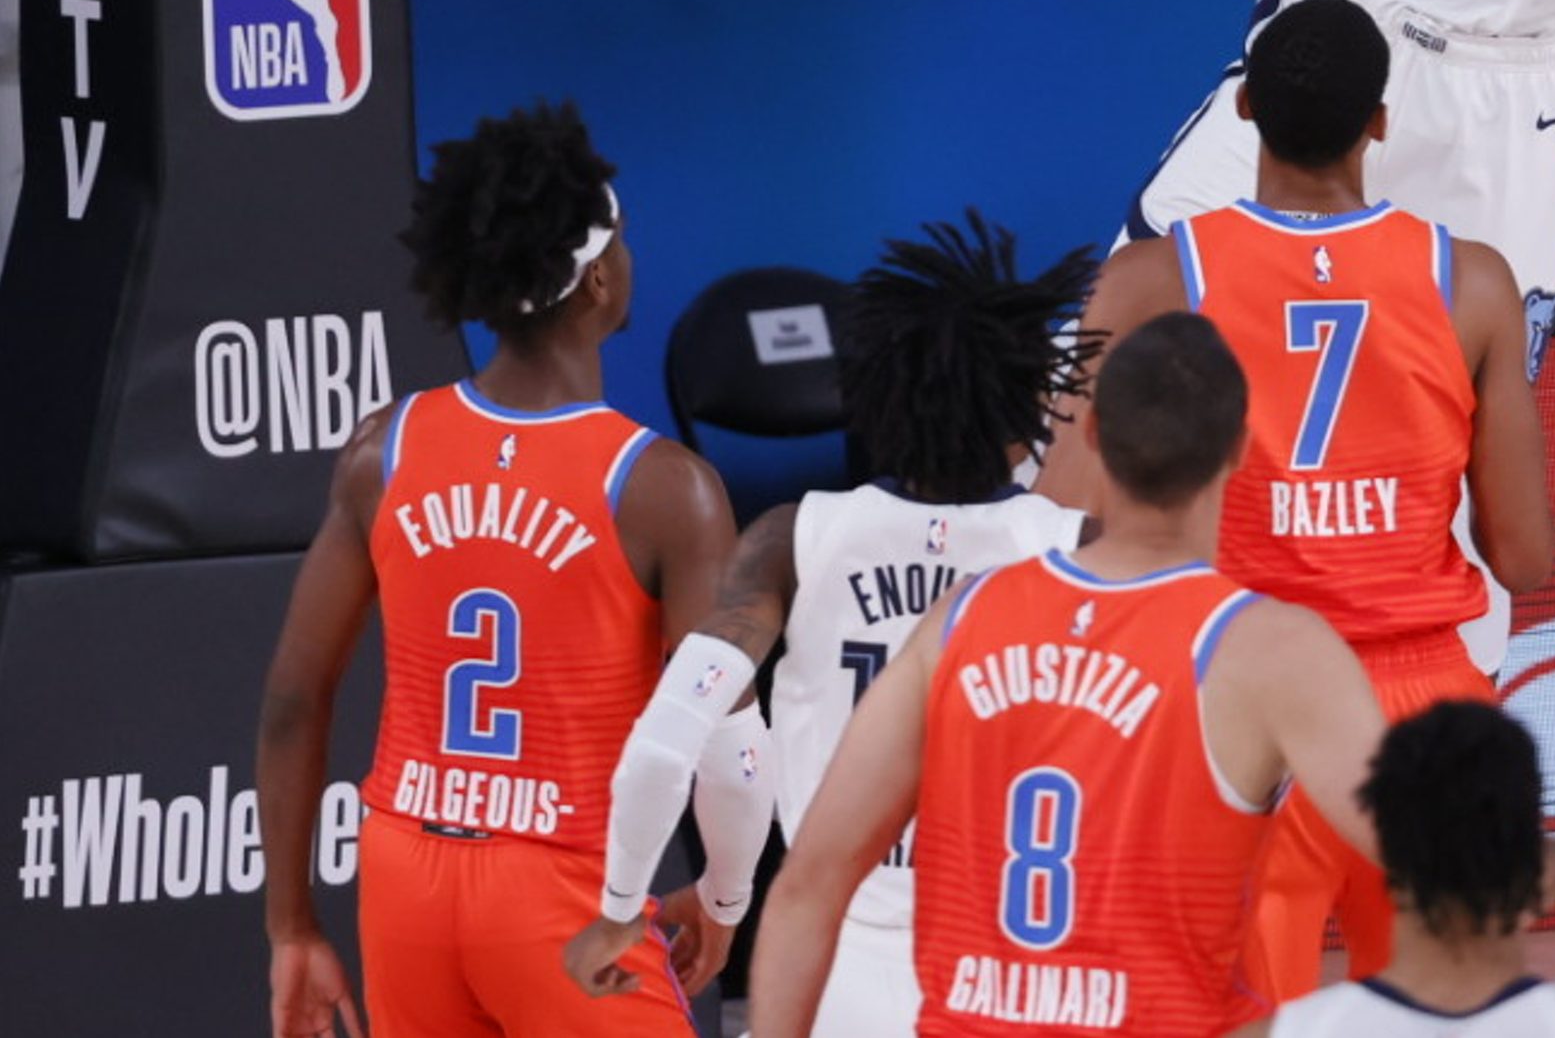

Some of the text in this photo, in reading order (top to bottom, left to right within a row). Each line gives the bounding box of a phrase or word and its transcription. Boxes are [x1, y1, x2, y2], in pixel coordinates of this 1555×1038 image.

[229, 21, 308, 90] NBA
[195, 310, 393, 458] @NBA
[1284, 299, 1370, 472] 7
[395, 482, 597, 573] EQUALITY
[1271, 477, 1400, 537] BAZLEY
[440, 586, 523, 762] 2
[958, 643, 1161, 739] GIUSTIZIA
[393, 758, 575, 836] GILGEOUS-
[1001, 765, 1082, 950] 8
[946, 954, 1128, 1030] GALLINARI
